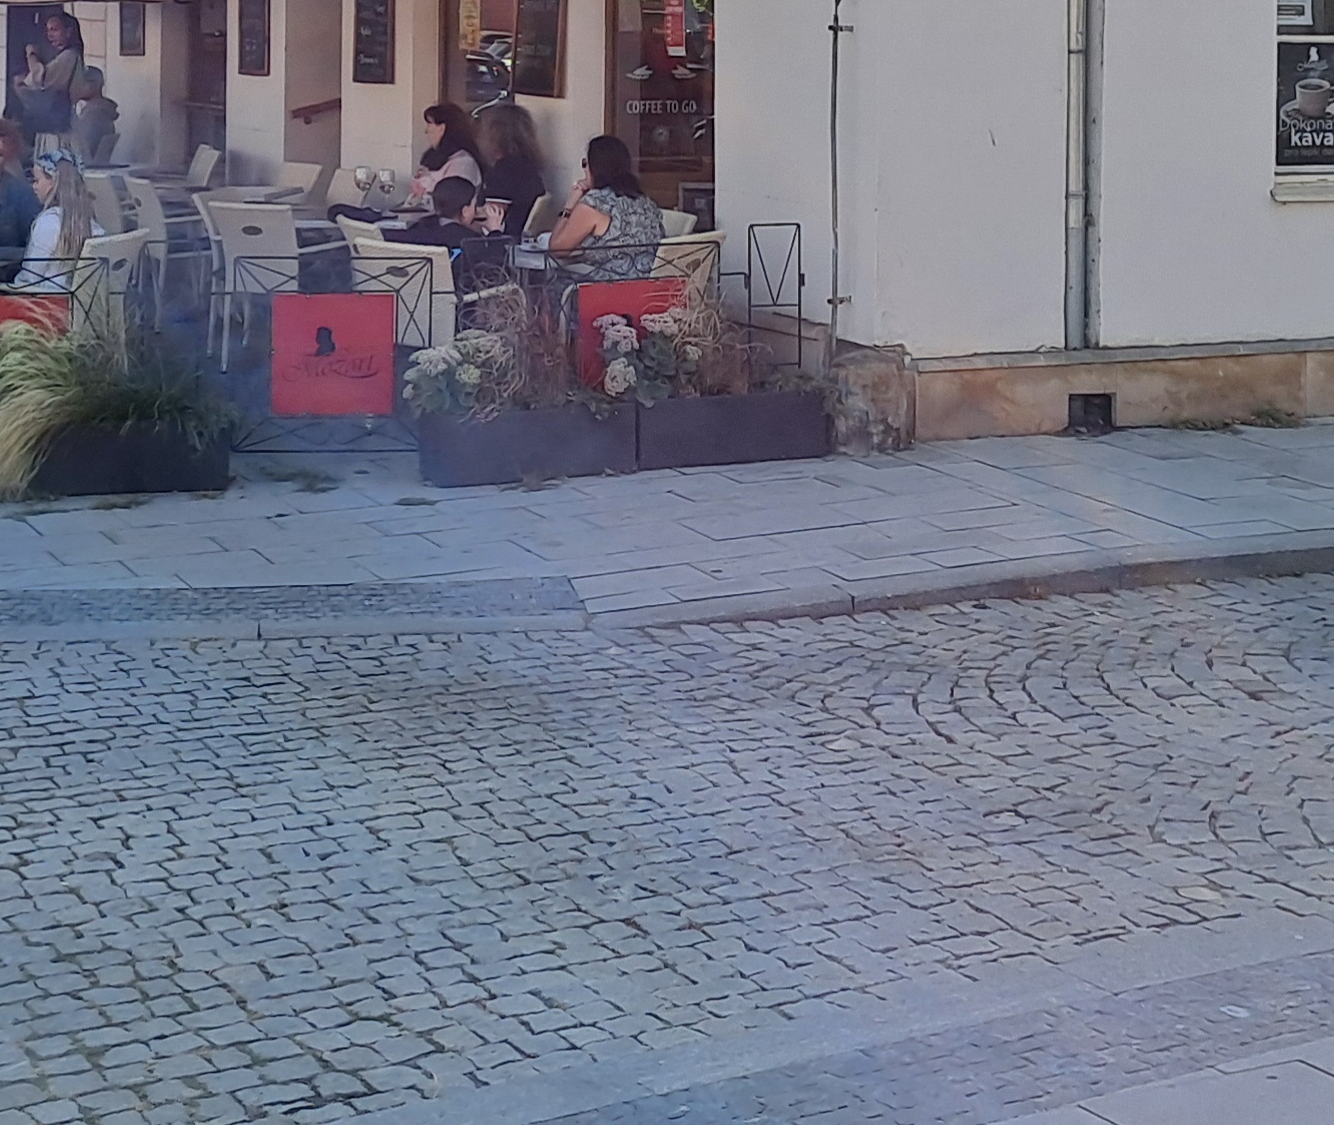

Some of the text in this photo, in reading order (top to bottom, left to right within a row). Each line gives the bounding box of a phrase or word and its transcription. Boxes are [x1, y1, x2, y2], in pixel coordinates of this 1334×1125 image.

[626, 100, 698, 114] COFFEE TO GO
